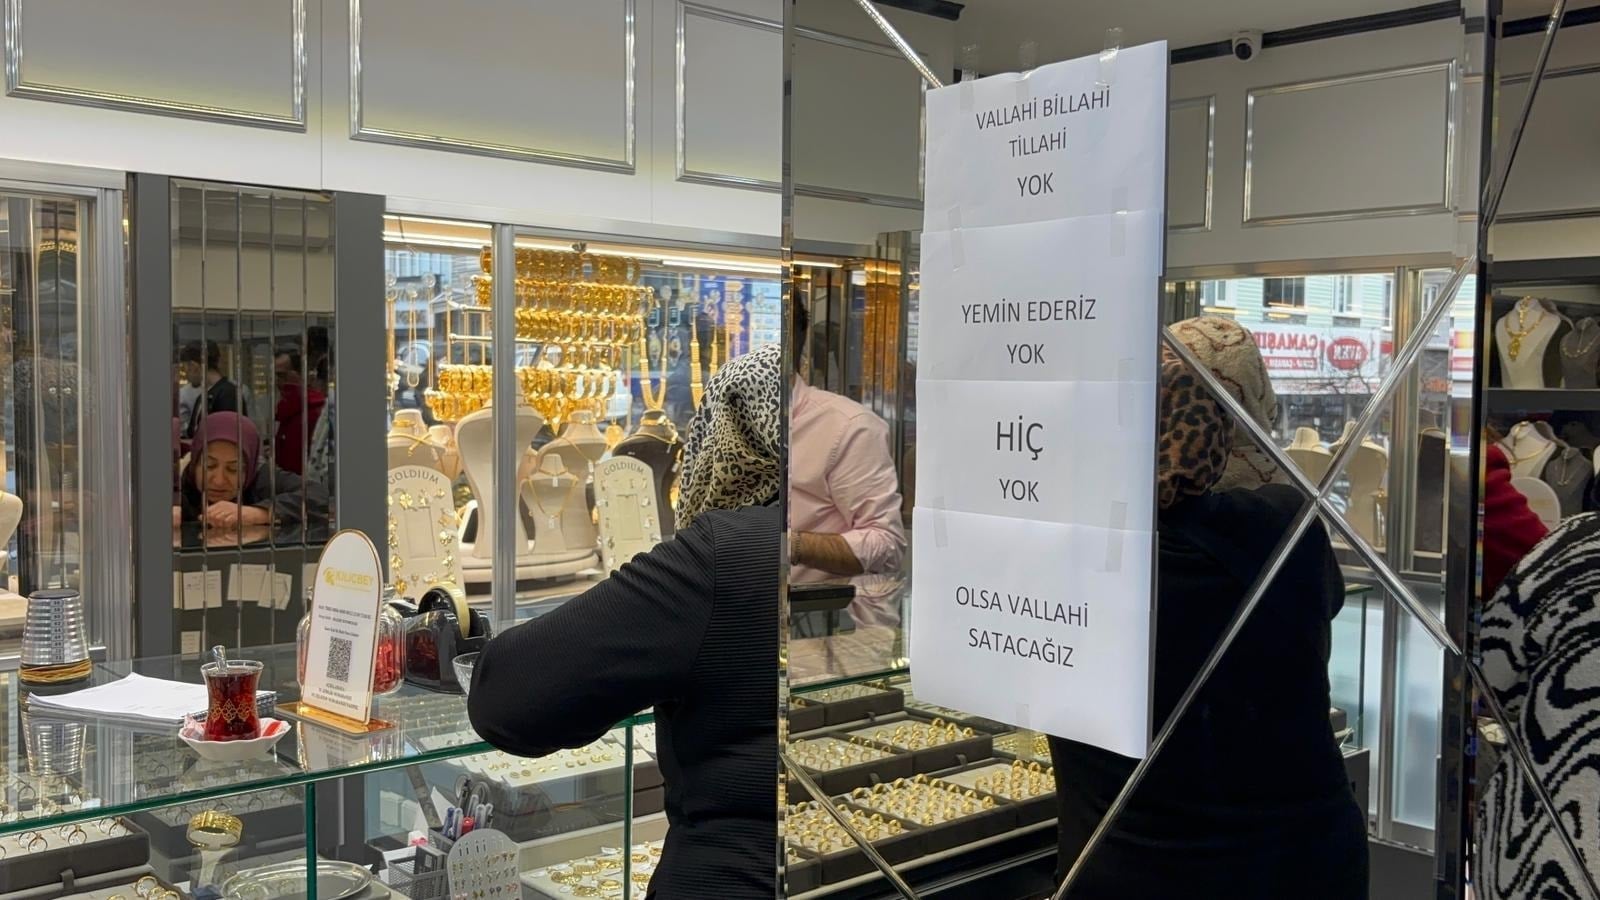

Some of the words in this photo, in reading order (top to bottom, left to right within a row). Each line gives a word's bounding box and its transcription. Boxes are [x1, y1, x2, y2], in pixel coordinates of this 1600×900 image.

[976, 97, 1037, 130] VALLAHİ
[1043, 85, 1110, 117] BİLLAHİ
[1008, 127, 1067, 158] TİLLAHİ
[1017, 172, 1054, 197] YOK
[961, 298, 1020, 324] YEMİN
[1027, 294, 1096, 321] EDERİZ
[1007, 343, 1045, 364] YOK
[996, 415, 1044, 461] HİÇ
[603, 461, 644, 475] GOLDIUM
[999, 478, 1039, 502] YOK
[956, 586, 1002, 612] OLSA
[1008, 594, 1088, 627] VALLAHİ
[968, 628, 1074, 667] SATACAĞIZ
